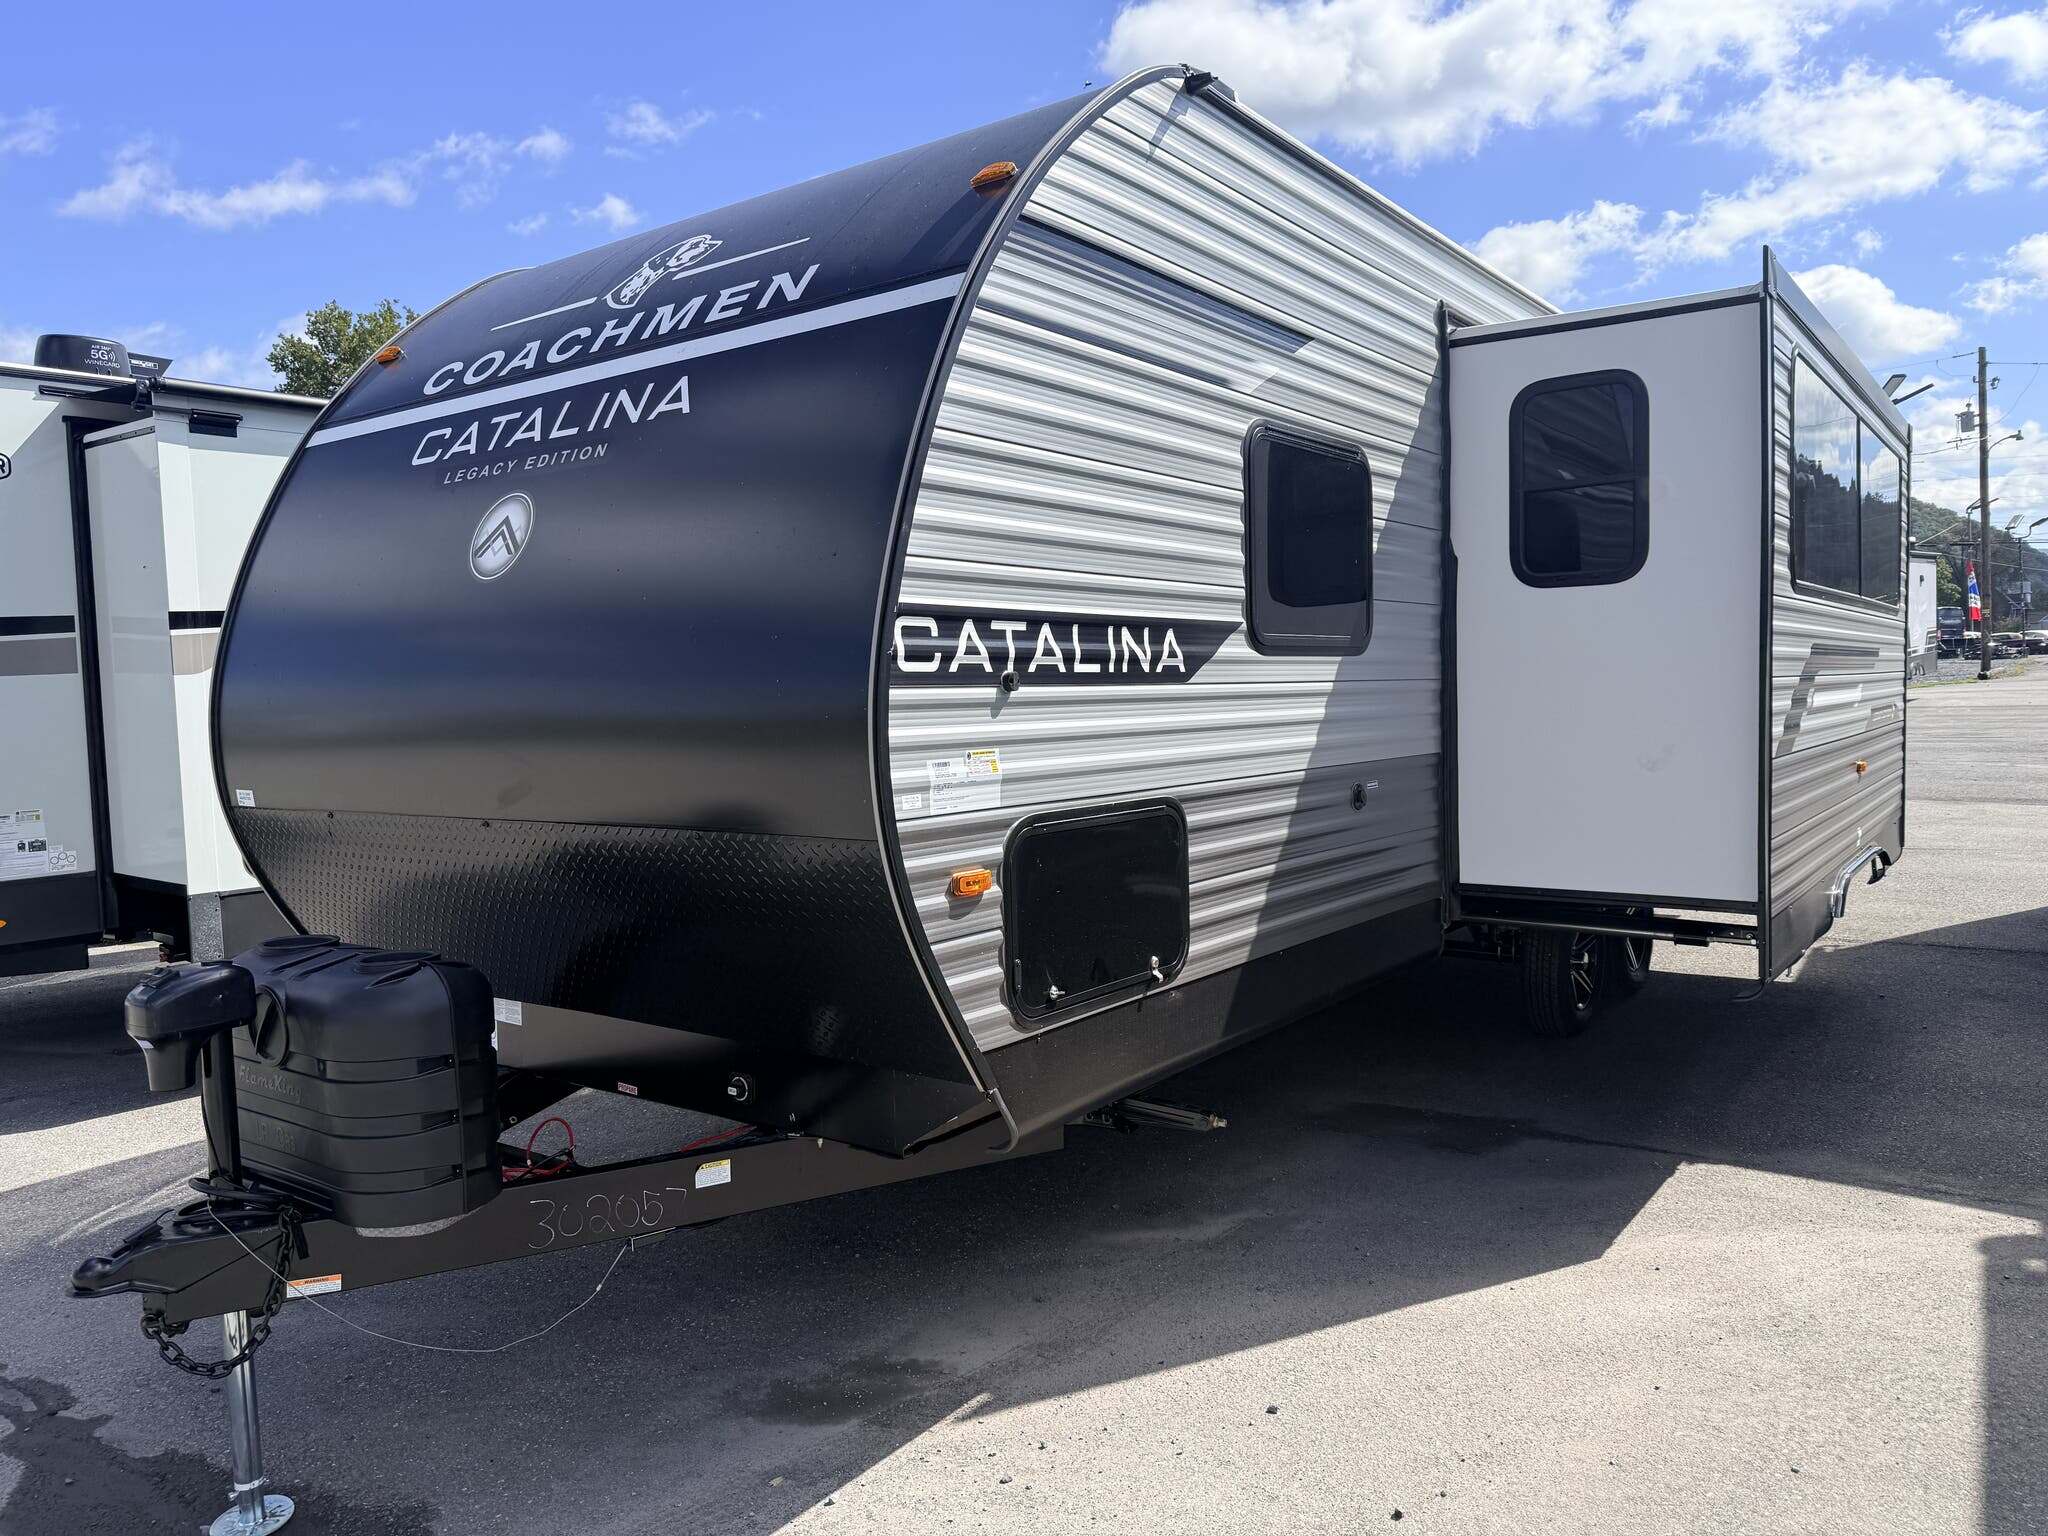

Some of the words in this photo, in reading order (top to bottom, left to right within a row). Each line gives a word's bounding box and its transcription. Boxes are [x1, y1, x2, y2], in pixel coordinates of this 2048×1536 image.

[90, 349, 108, 360] 5G
[423, 264, 821, 395] COACHMEN
[411, 375, 691, 466] CATALINA
[443, 459, 518, 485] LEGACY
[523, 442, 609, 471] EDITION
[894, 615, 1187, 673] CATALINA
[528, 1187, 688, 1249] 302057
